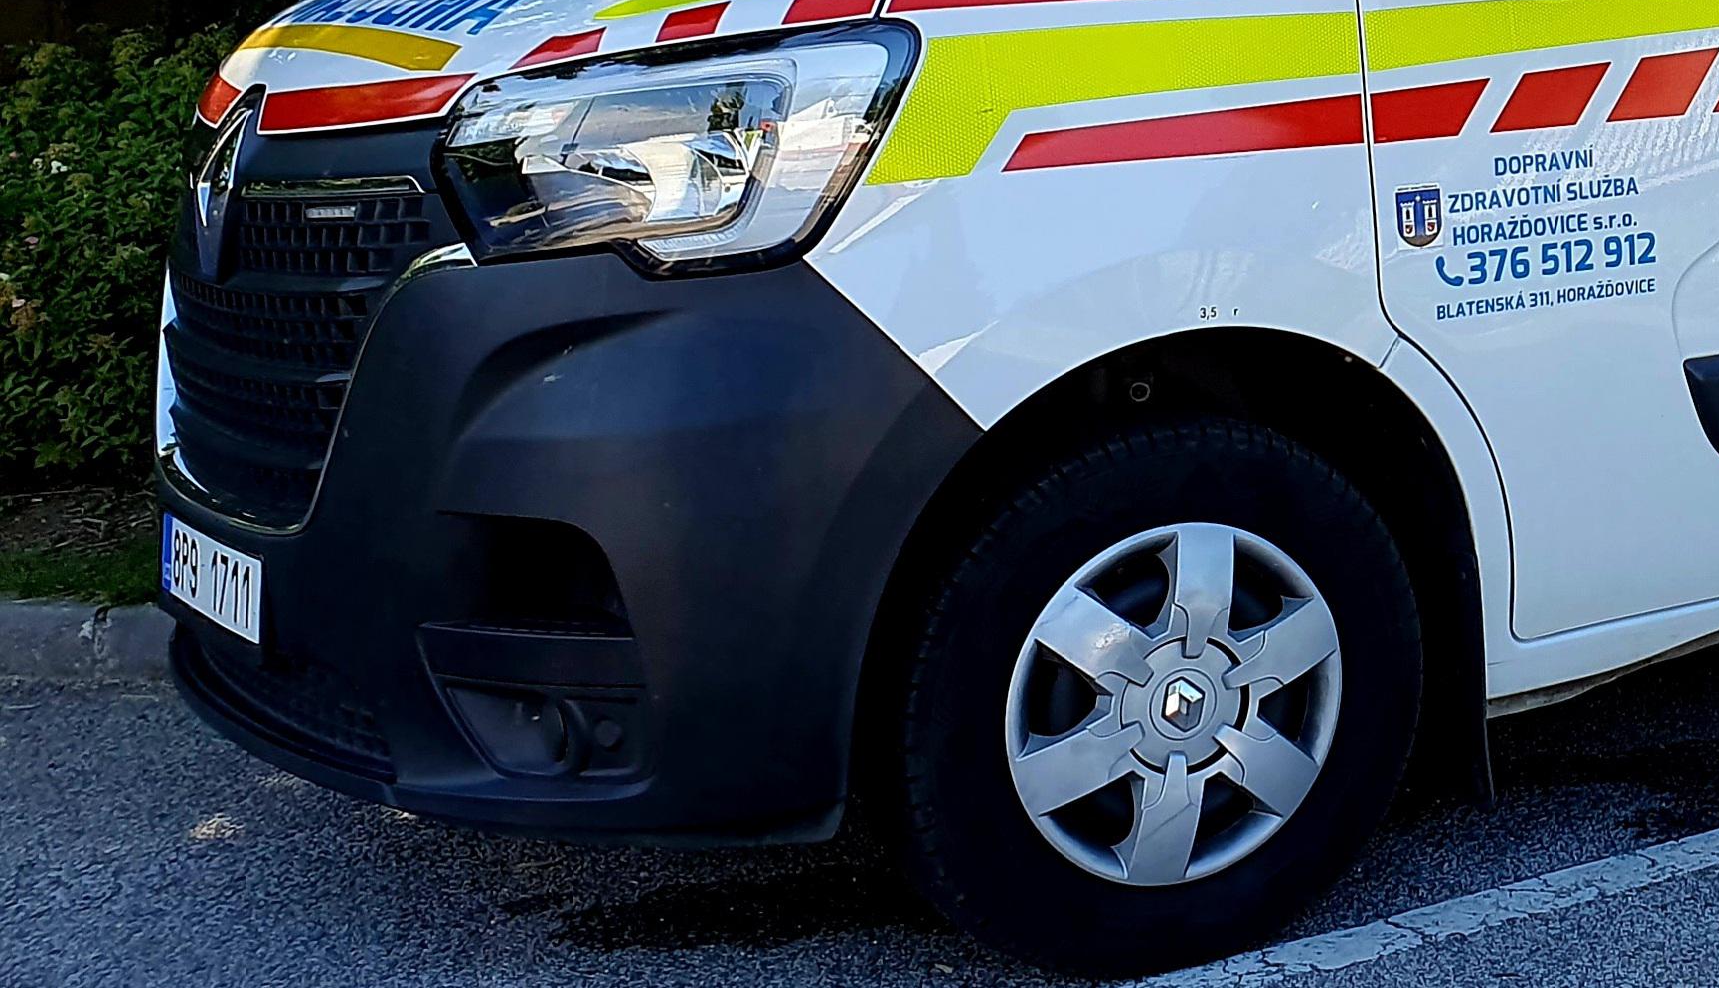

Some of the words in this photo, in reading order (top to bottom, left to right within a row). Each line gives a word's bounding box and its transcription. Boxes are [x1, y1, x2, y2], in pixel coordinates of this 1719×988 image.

[1494, 145, 1594, 176] DOPRAVNÍ
[1448, 179, 1561, 214] ZDRAVOTNÍ
[1566, 175, 1639, 202] SLUŽBA
[1452, 213, 1588, 247] HORAŽĎOVICE
[1593, 212, 1638, 231] s.r.o.
[1467, 246, 1530, 285] 376
[1541, 239, 1594, 276] 512
[1604, 232, 1657, 268] 912
[1199, 306, 1217, 320] 3,5
[1436, 290, 1525, 320] BLATENSKÁ
[1529, 291, 1554, 308] 311,
[1557, 279, 1656, 304] HORAŽĎOVICE
[173, 529, 199, 599] 8P9
[210, 550, 251, 630] 1711
